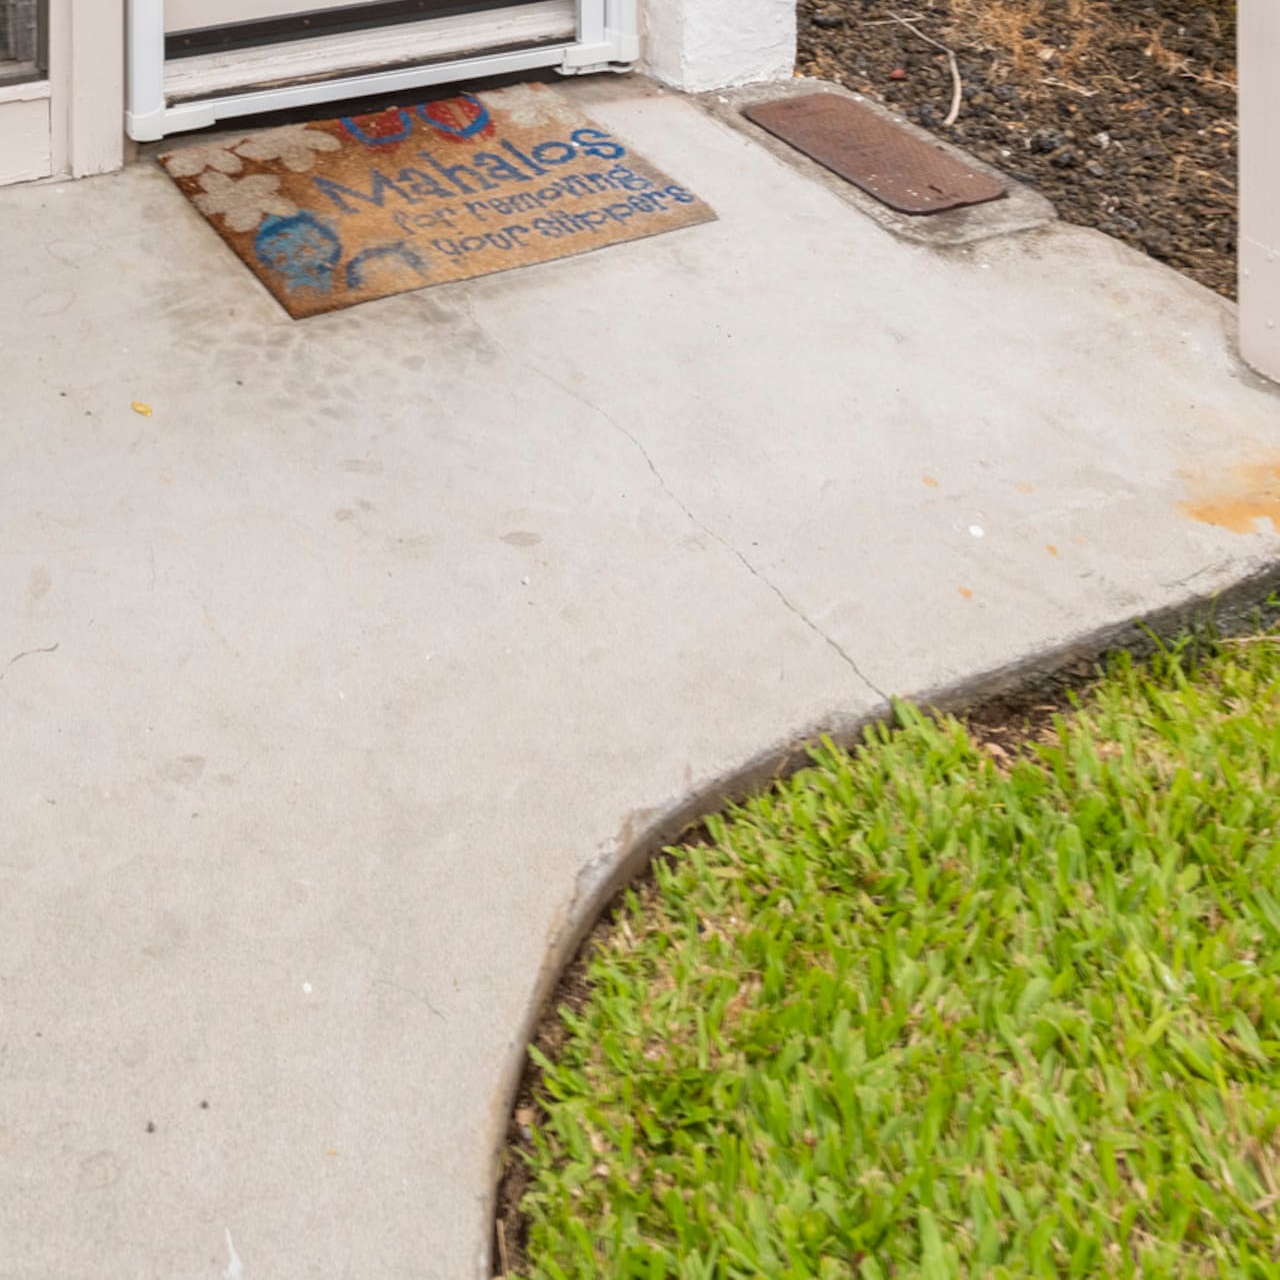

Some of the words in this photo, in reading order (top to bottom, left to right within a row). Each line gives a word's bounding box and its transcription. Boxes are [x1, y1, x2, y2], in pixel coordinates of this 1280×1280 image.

[312, 128, 626, 215] Mahalos
[392, 206, 459, 235] for
[467, 163, 654, 221] removing
[430, 224, 530, 264] your
[532, 184, 695, 238] slippers
